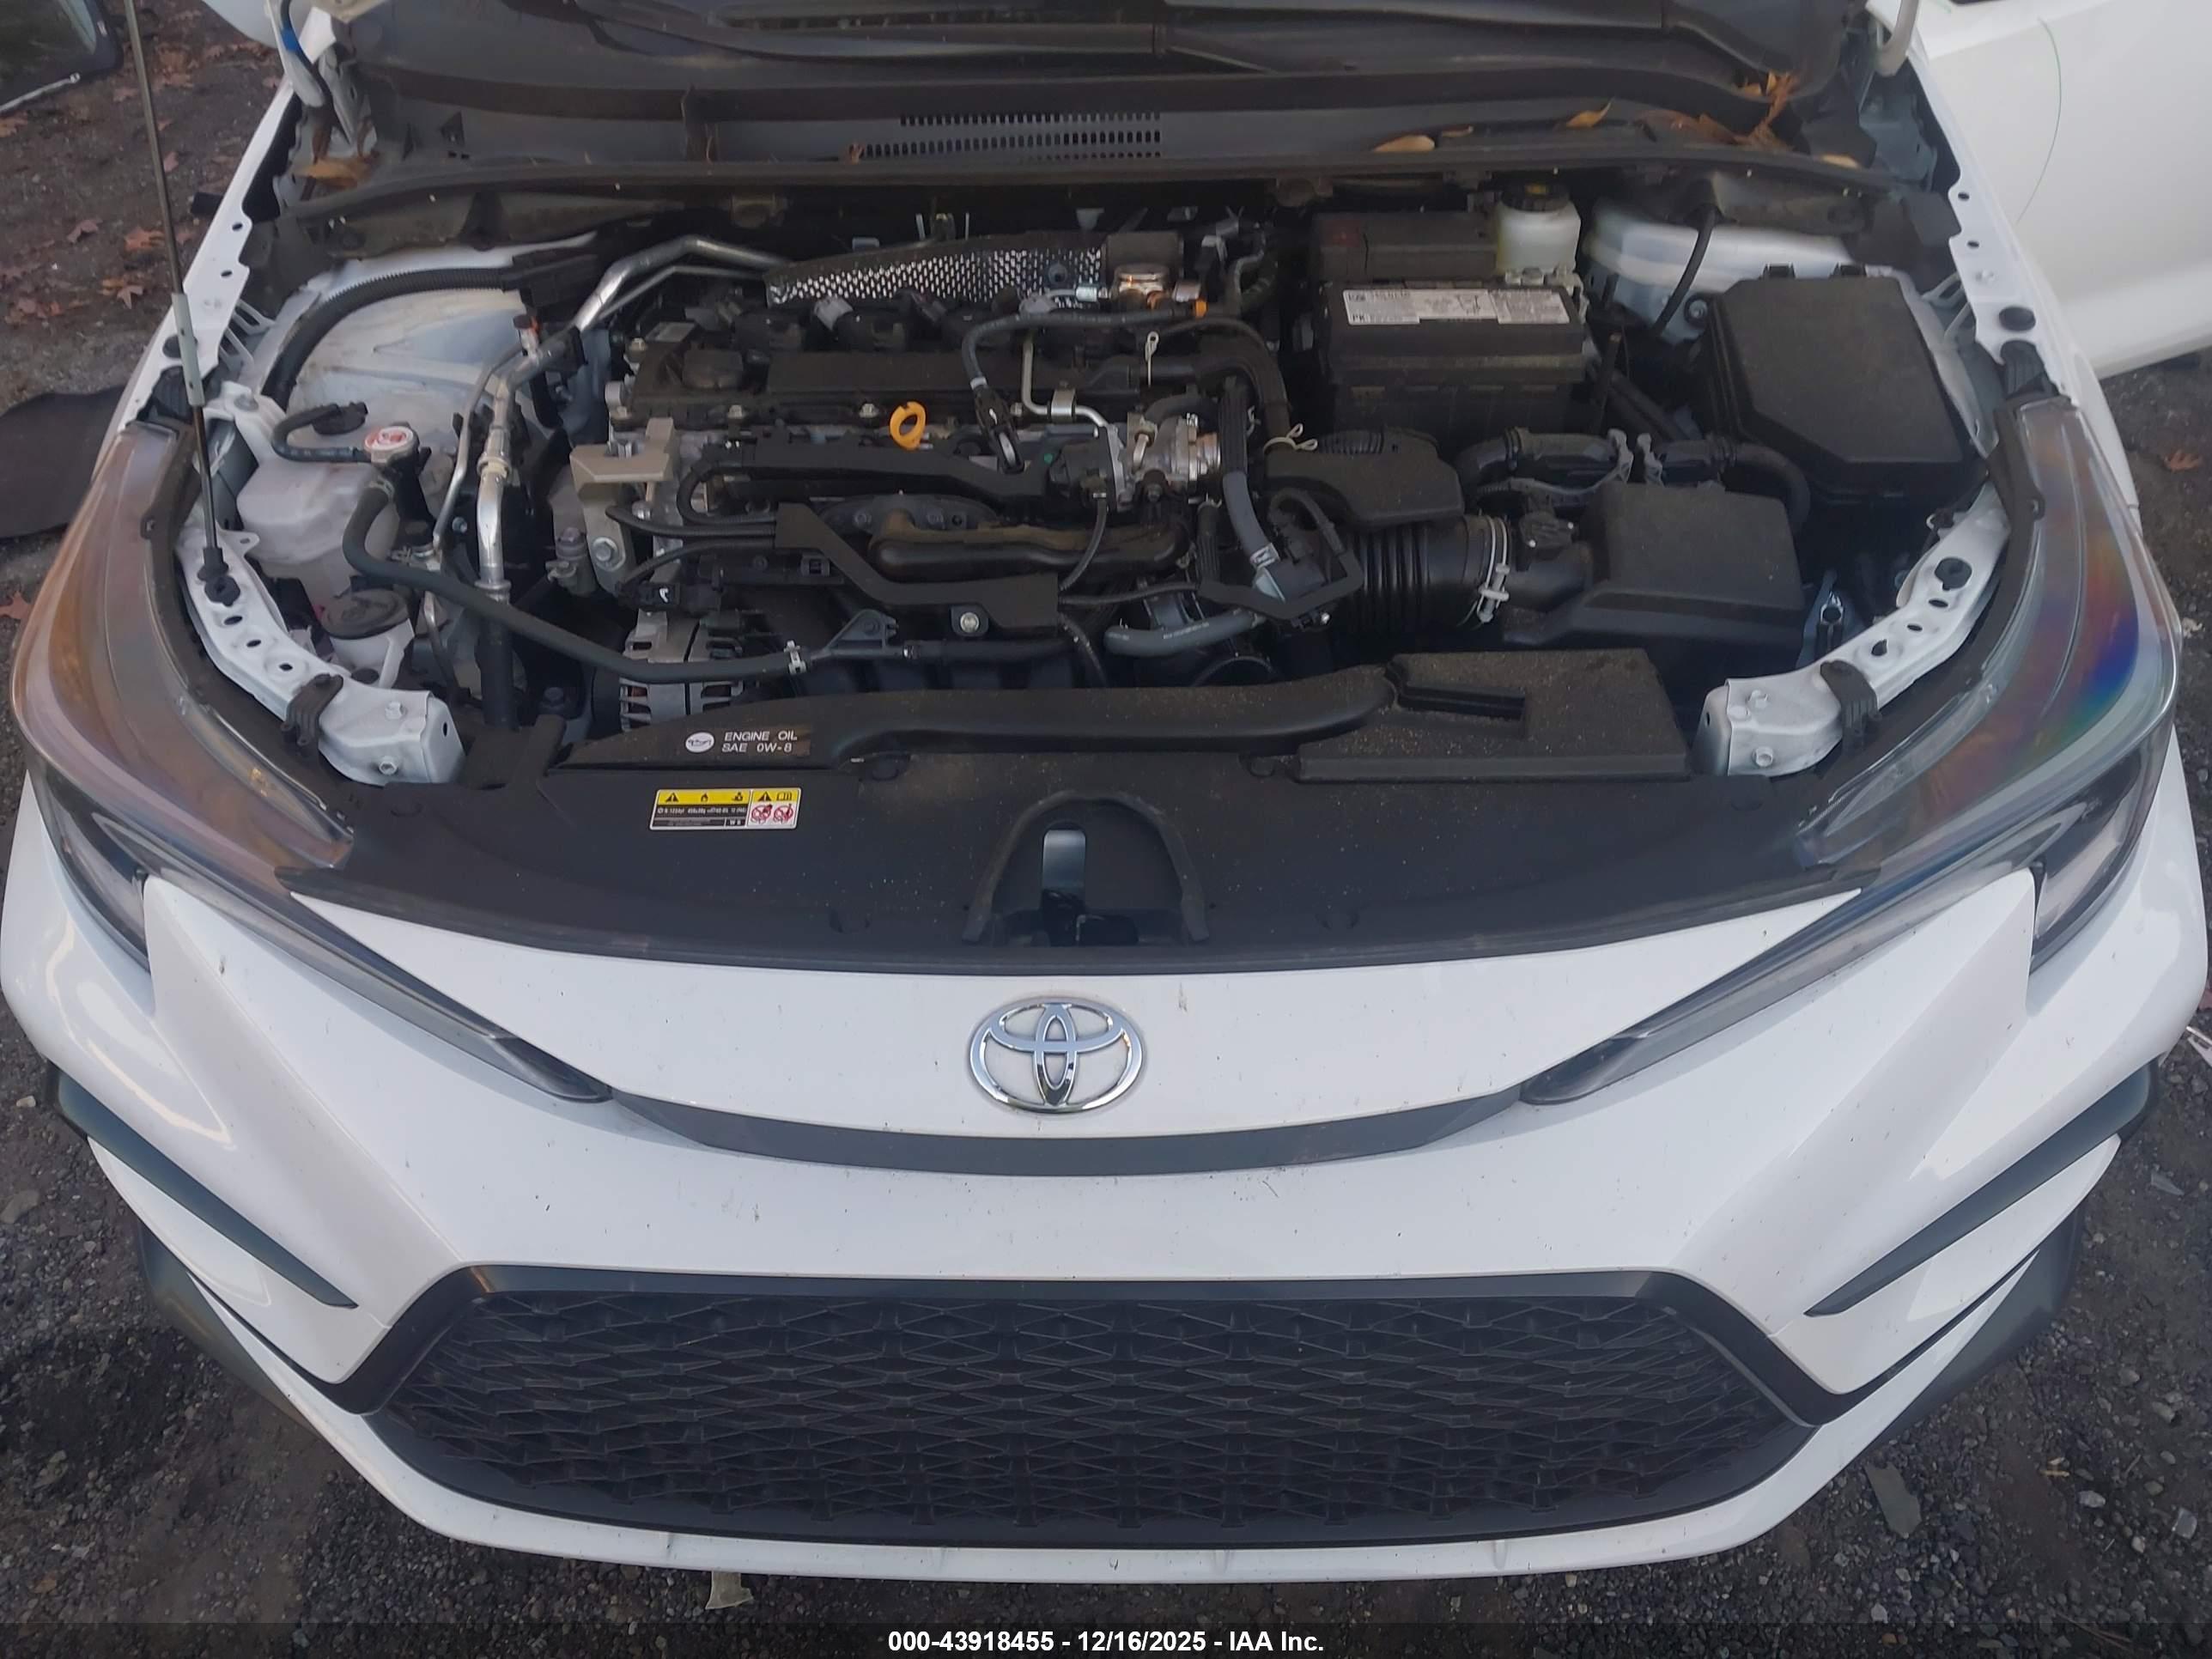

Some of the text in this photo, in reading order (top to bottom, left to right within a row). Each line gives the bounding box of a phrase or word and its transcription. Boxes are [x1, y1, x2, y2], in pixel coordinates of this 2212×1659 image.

[724, 730, 798, 742] ENGINE OIL
[721, 742, 792, 753] SAE 0W-8
